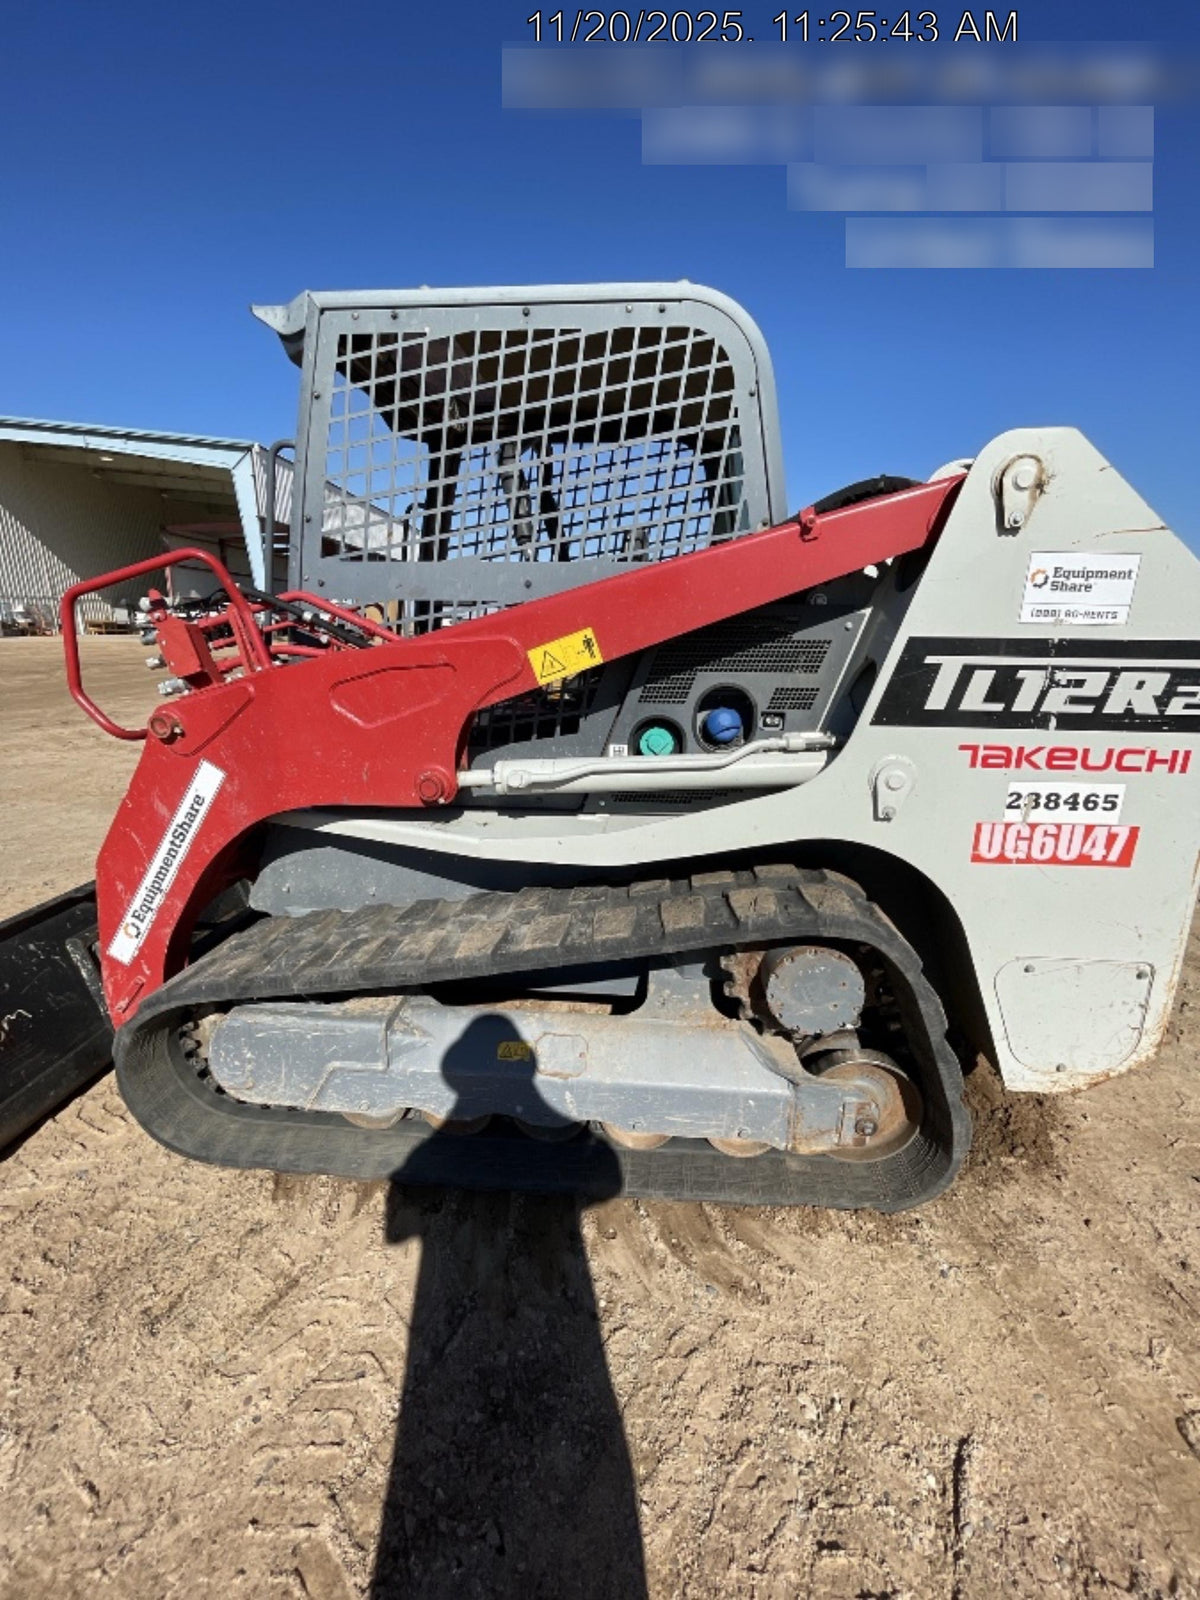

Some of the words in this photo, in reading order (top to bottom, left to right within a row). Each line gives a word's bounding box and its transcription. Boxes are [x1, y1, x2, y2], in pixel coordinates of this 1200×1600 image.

[1049, 580, 1093, 593] Share
[1052, 566, 1134, 582] Equipment
[976, 823, 1131, 862] UG6U47
[130, 793, 206, 925] EquipmentShare
